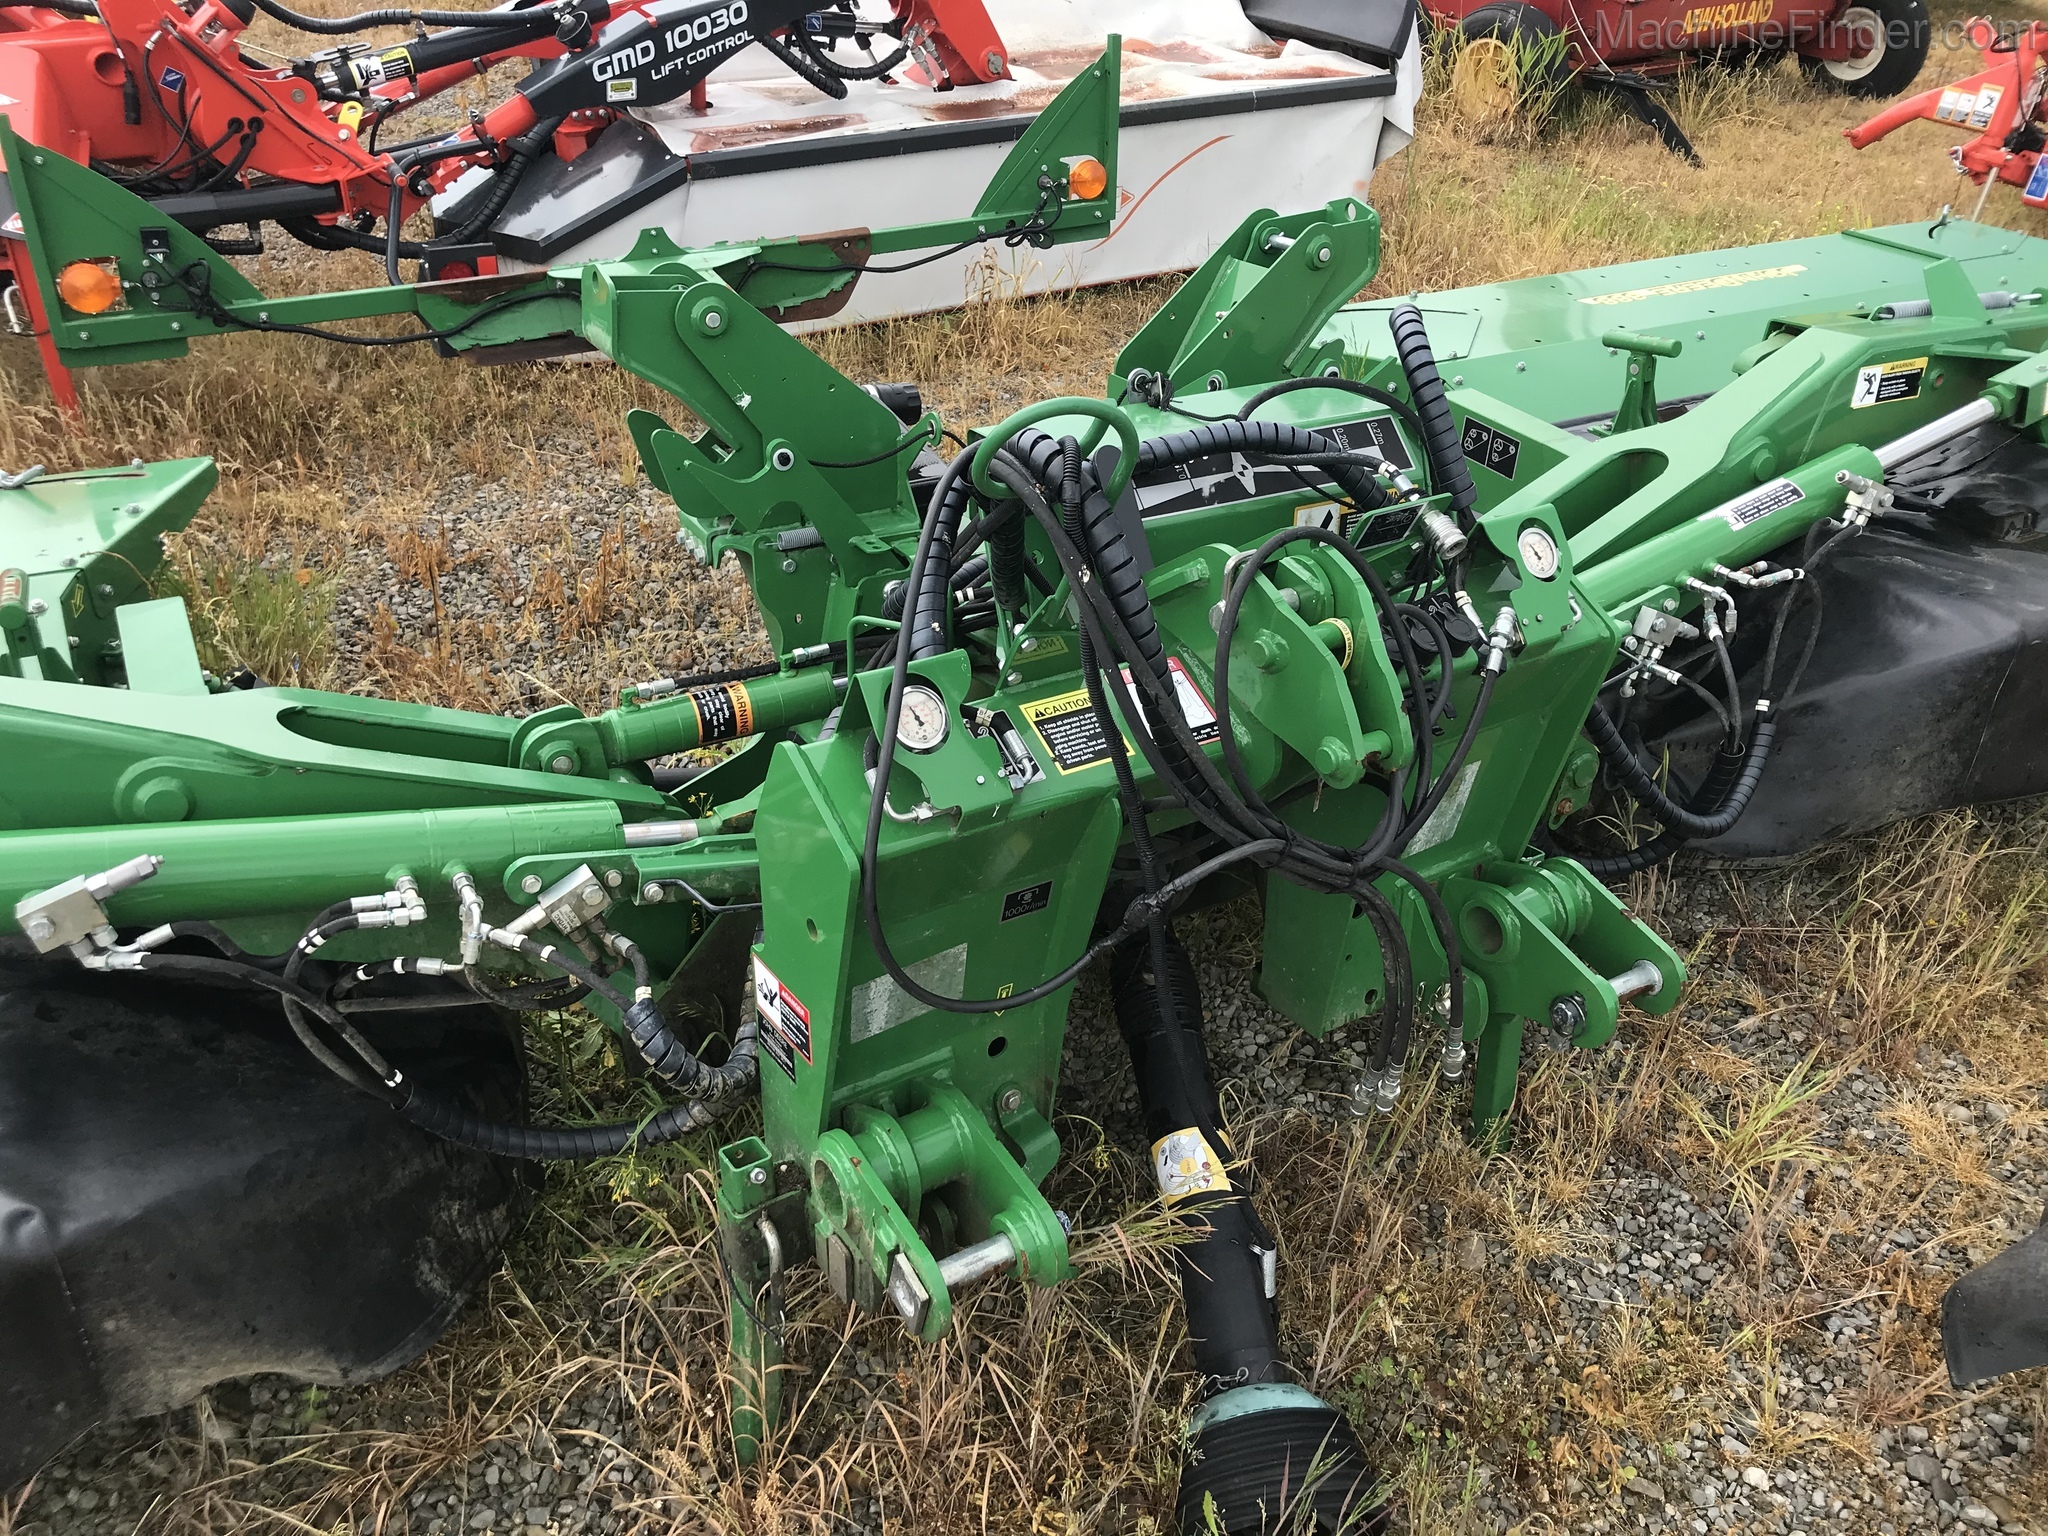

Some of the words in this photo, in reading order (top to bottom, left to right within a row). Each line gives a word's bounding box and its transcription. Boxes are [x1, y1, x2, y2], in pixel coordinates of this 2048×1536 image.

[1682, 6, 1715, 34] NEW
[1711, 0, 1773, 30] HOLLAND
[593, 39, 656, 82] GMD
[665, 0, 748, 53] 10030
[651, 57, 684, 80] LIFT
[686, 30, 754, 66] CONTROL
[1336, 428, 1350, 451] 0.20m
[1370, 422, 1384, 445] 0.27m
[732, 684, 749, 735] WARNING
[1043, 696, 1092, 716] CAUTION
